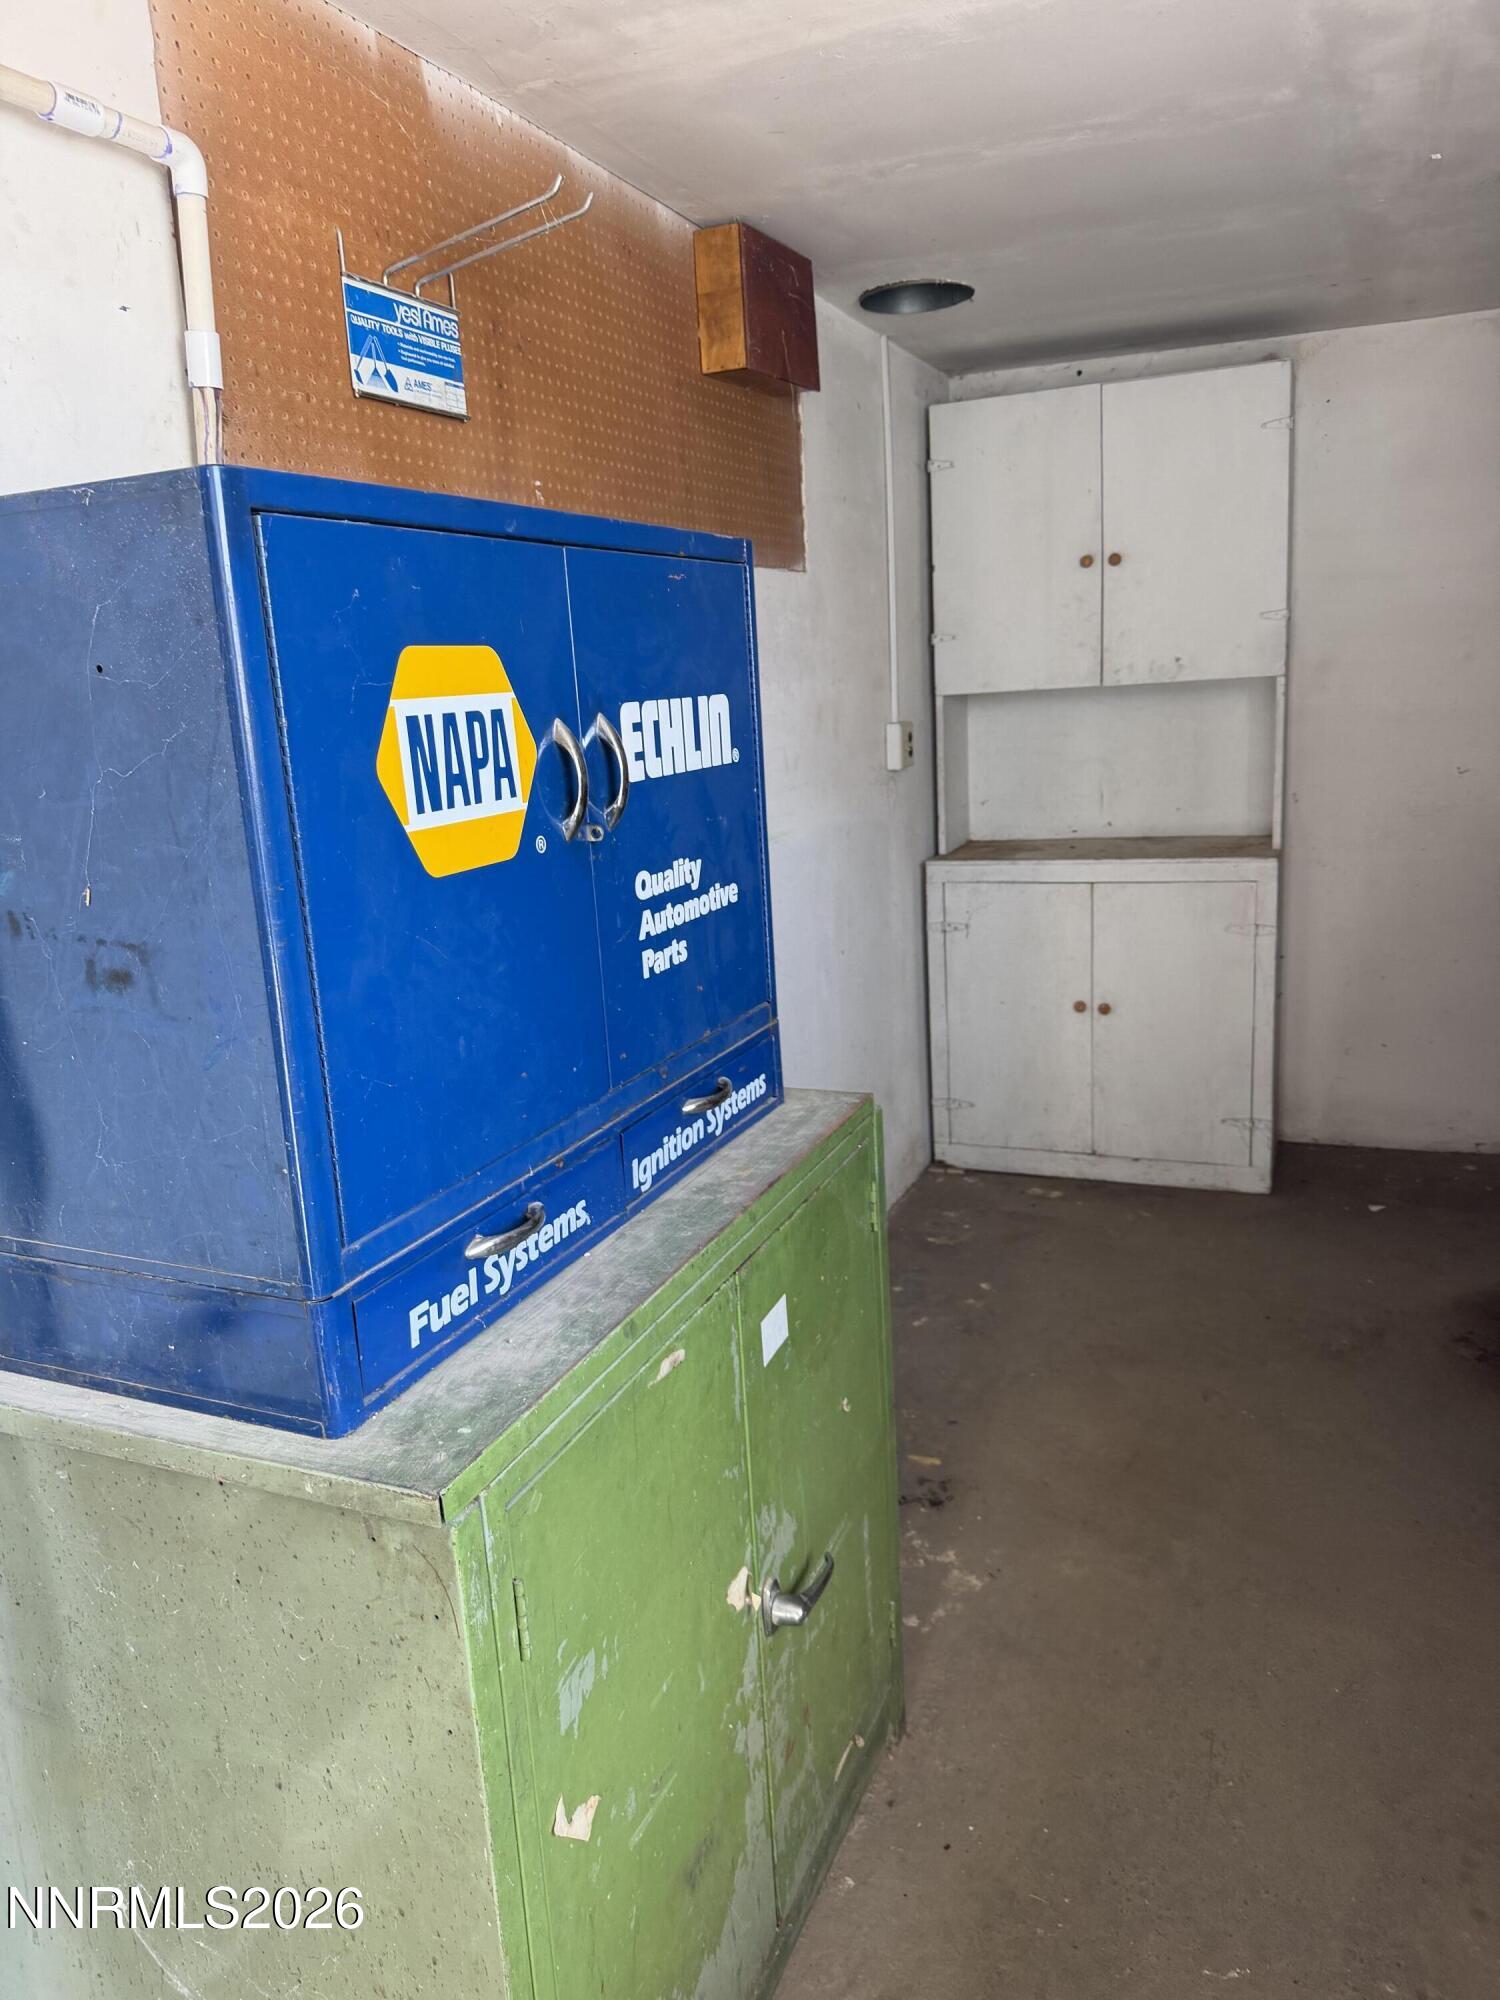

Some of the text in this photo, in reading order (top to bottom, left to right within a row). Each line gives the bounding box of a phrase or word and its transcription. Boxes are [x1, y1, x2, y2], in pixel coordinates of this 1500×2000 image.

[350, 313, 380, 331] QUALITY
[381, 323, 403, 338] TOOLS
[423, 310, 459, 338] Ames
[414, 378, 432, 391] AMES
[405, 707, 517, 815] NAPA
[635, 857, 702, 901] Quality
[638, 881, 739, 941] Automotive
[641, 937, 688, 980] Parts
[631, 1073, 767, 1193] Ignition Systems
[409, 1267, 479, 1349] Fuel
